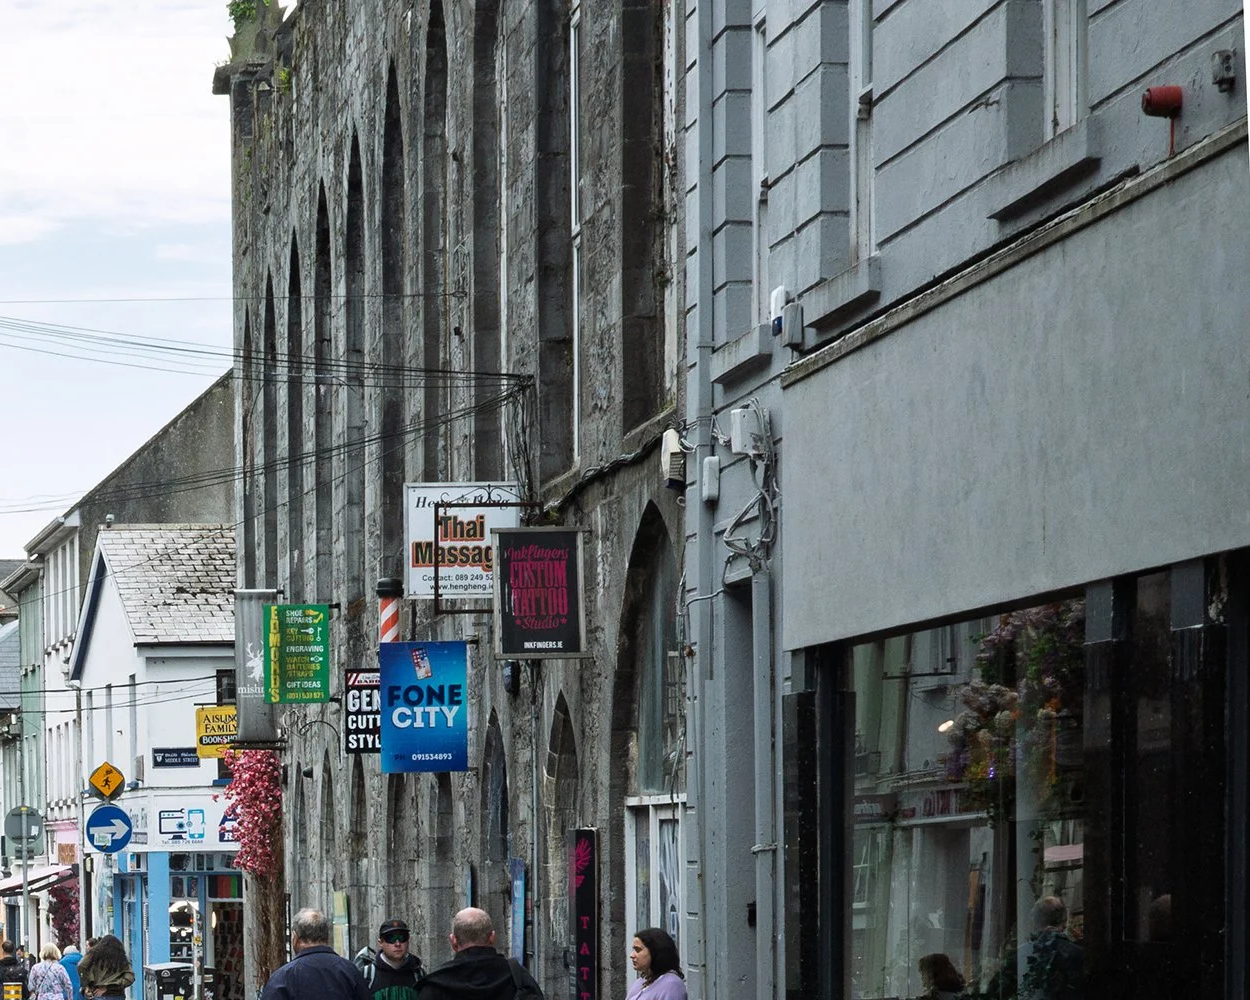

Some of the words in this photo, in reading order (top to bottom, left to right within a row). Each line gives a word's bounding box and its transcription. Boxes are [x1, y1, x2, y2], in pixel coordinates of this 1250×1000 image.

[439, 515, 486, 541] Thai
[422, 574, 453, 582] Conact:
[510, 560, 568, 588] CUSTOM
[512, 587, 568, 617] TATTOO
[285, 609, 303, 617] SHOE
[522, 616, 560, 630] Studio
[286, 645, 324, 653] ENGRAVING
[523, 641, 563, 649] INKFINGERS.IE
[388, 684, 463, 707] FONE
[392, 706, 460, 729] CITY
[205, 723, 238, 734] FAMILY
[411, 753, 453, 761] 091534893
